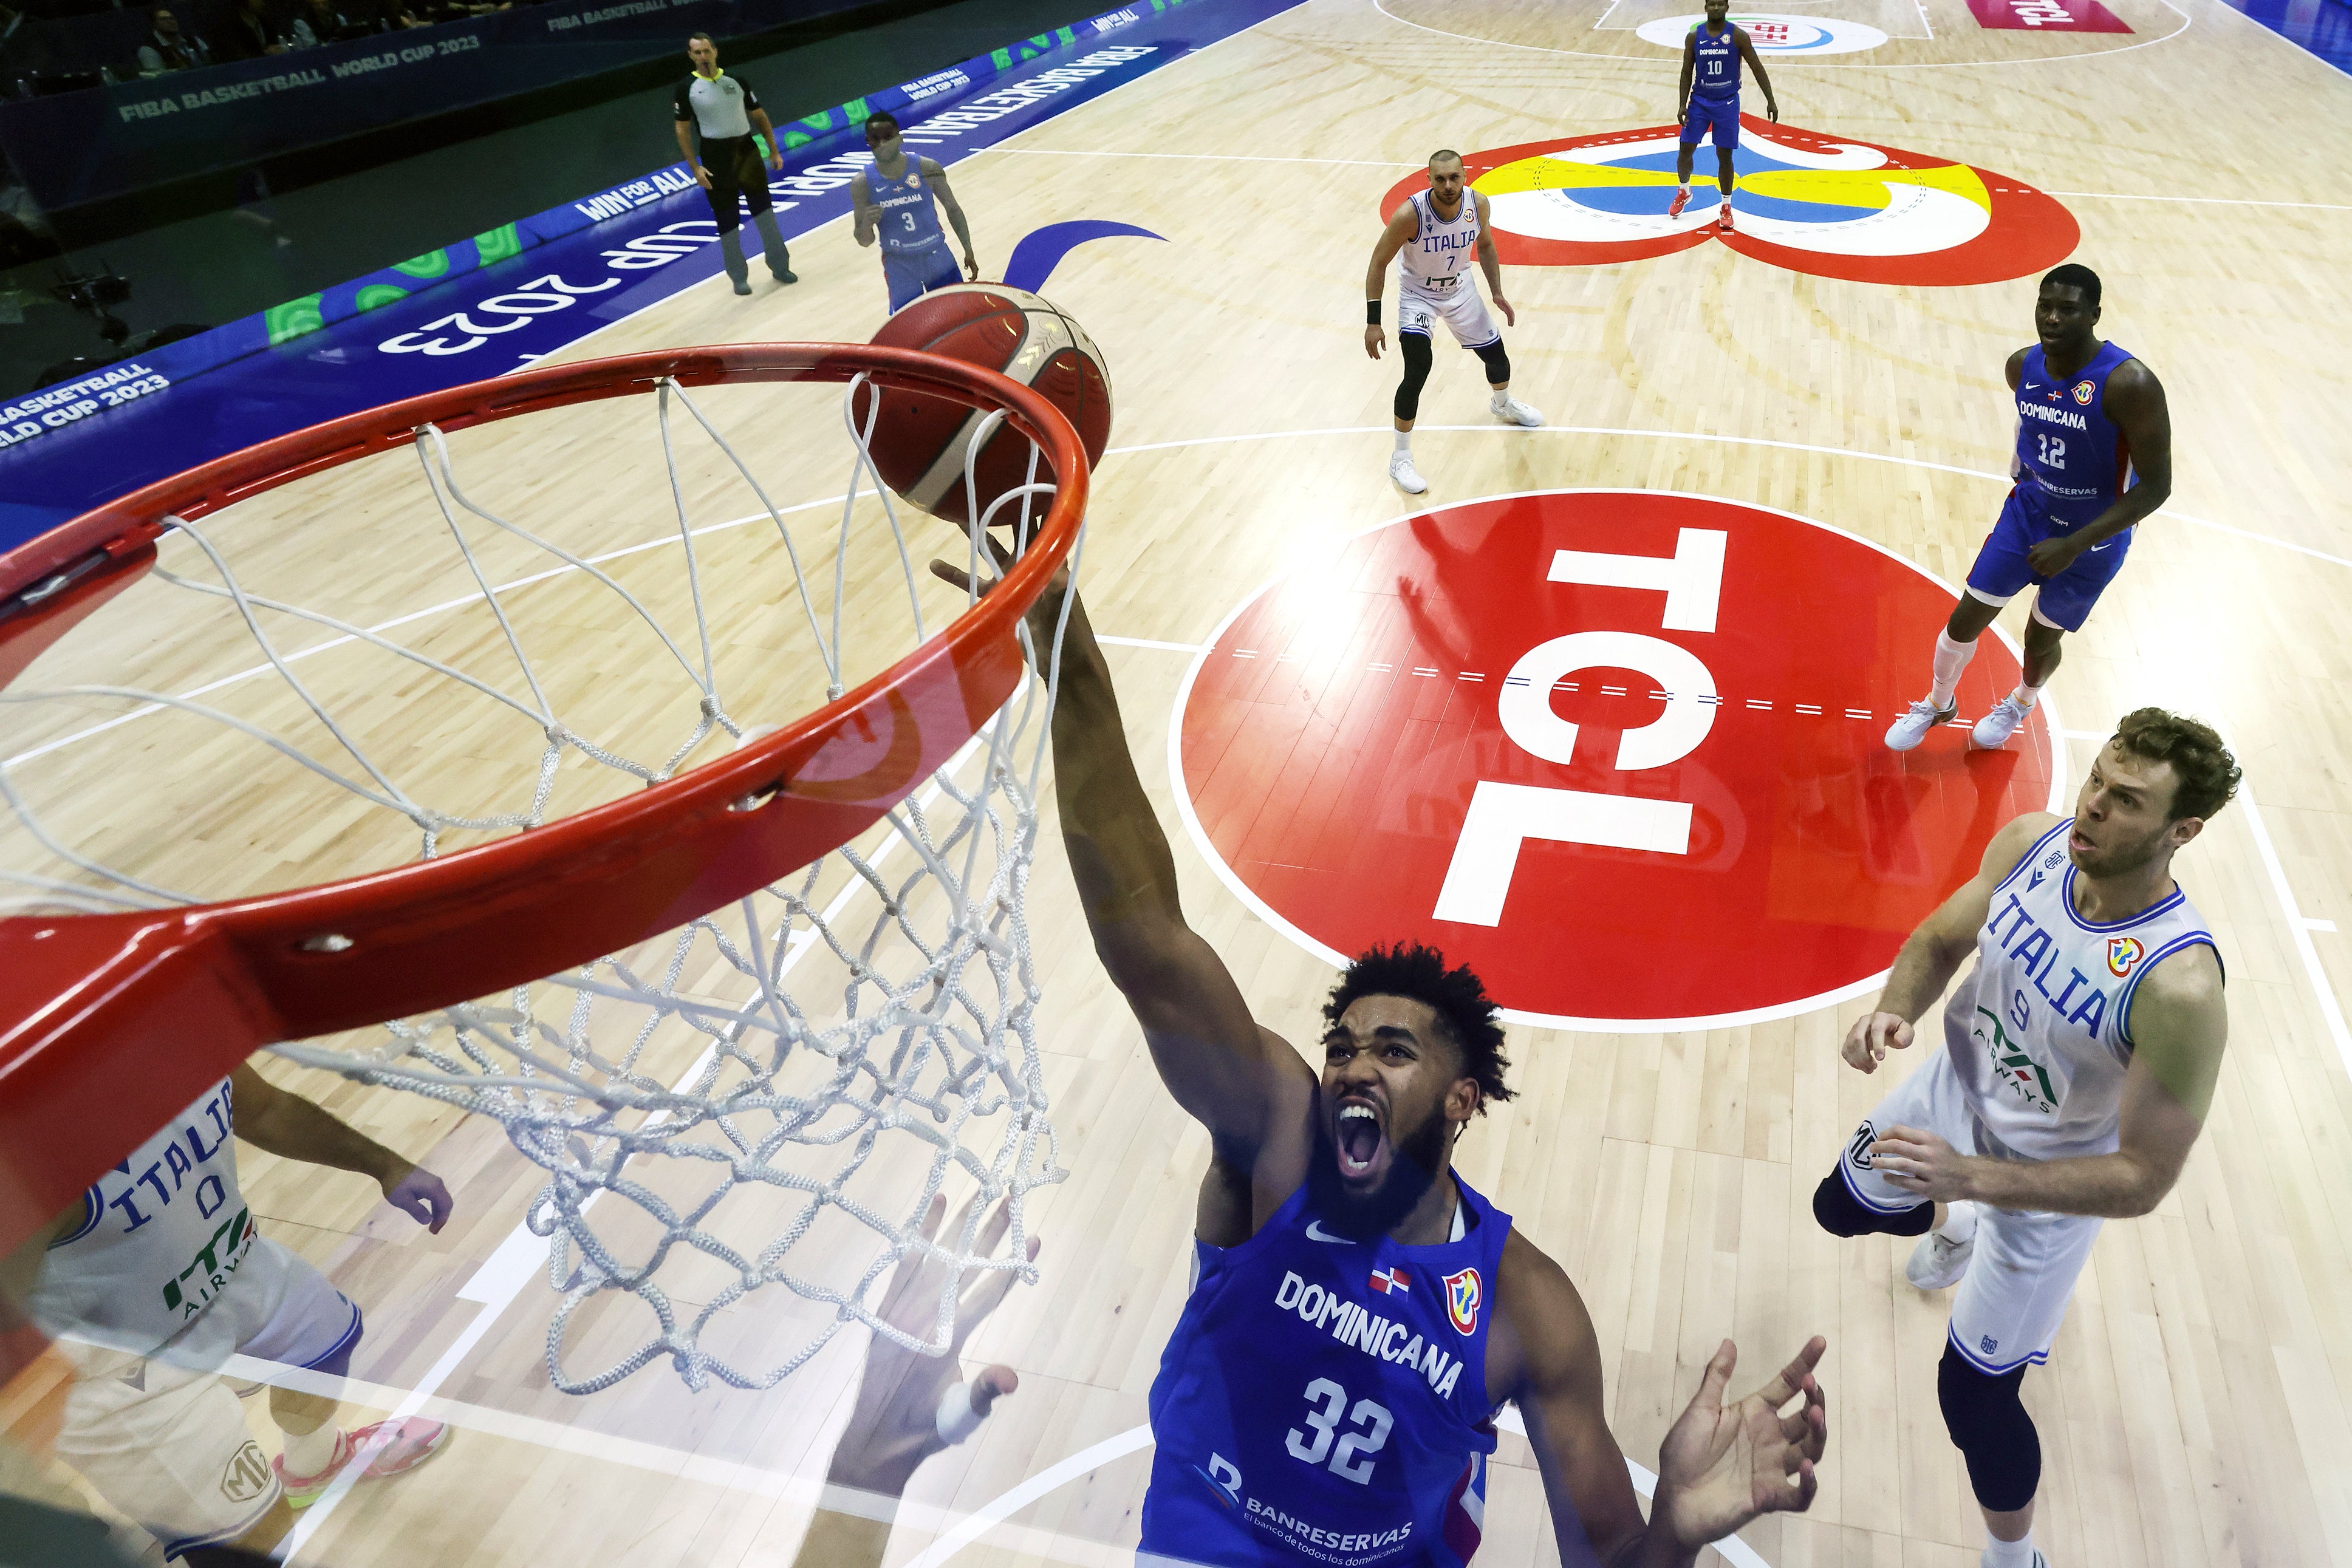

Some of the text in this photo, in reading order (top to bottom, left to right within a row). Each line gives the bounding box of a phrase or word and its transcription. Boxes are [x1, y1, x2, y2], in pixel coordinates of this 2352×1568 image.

[547, 0, 668, 32] FIBA BASKETBALL
[1090, 16, 1115, 32] WIN
[1118, 8, 1140, 24] ALL
[2009, 0, 2075, 26] TCL
[1065, 45, 1159, 67] FIBA
[1707, 60, 1723, 75] 10
[118, 34, 480, 122] FIBA BASKETBALL WORLD CUP 2023
[900, 68, 963, 94] FIBA BASKETBALL
[908, 74, 971, 101] WORLD CUP 2023
[574, 167, 698, 222] WIN FOR ALL
[879, 193, 923, 208] DOMINICANA
[901, 212, 916, 231] 3
[1423, 230, 1475, 253] ITALIA
[1446, 256, 1455, 271] 7
[377, 274, 622, 356] 2023
[41, 399, 99, 427] CUP
[98, 374, 170, 407] 2023
[2020, 400, 2087, 431] DOMINICANA
[2037, 433, 2066, 470] 12
[2037, 475, 2097, 495] BANRESERVAS
[2049, 515, 2069, 527] DOM
[1431, 527, 1729, 928] TCL
[1987, 893, 2108, 1040] ITALIA
[2009, 989, 2031, 1032] 9
[1973, 1028, 2051, 1114] AIRWAYS
[109, 1080, 234, 1234] ITALIA
[1274, 1269, 1464, 1400] DOMINICANA
[1284, 1376, 1395, 1485] 32
[1243, 1512, 1406, 1567] El banco de todos los dominicanos
[1246, 1497, 1414, 1552] BANRESERVAS
